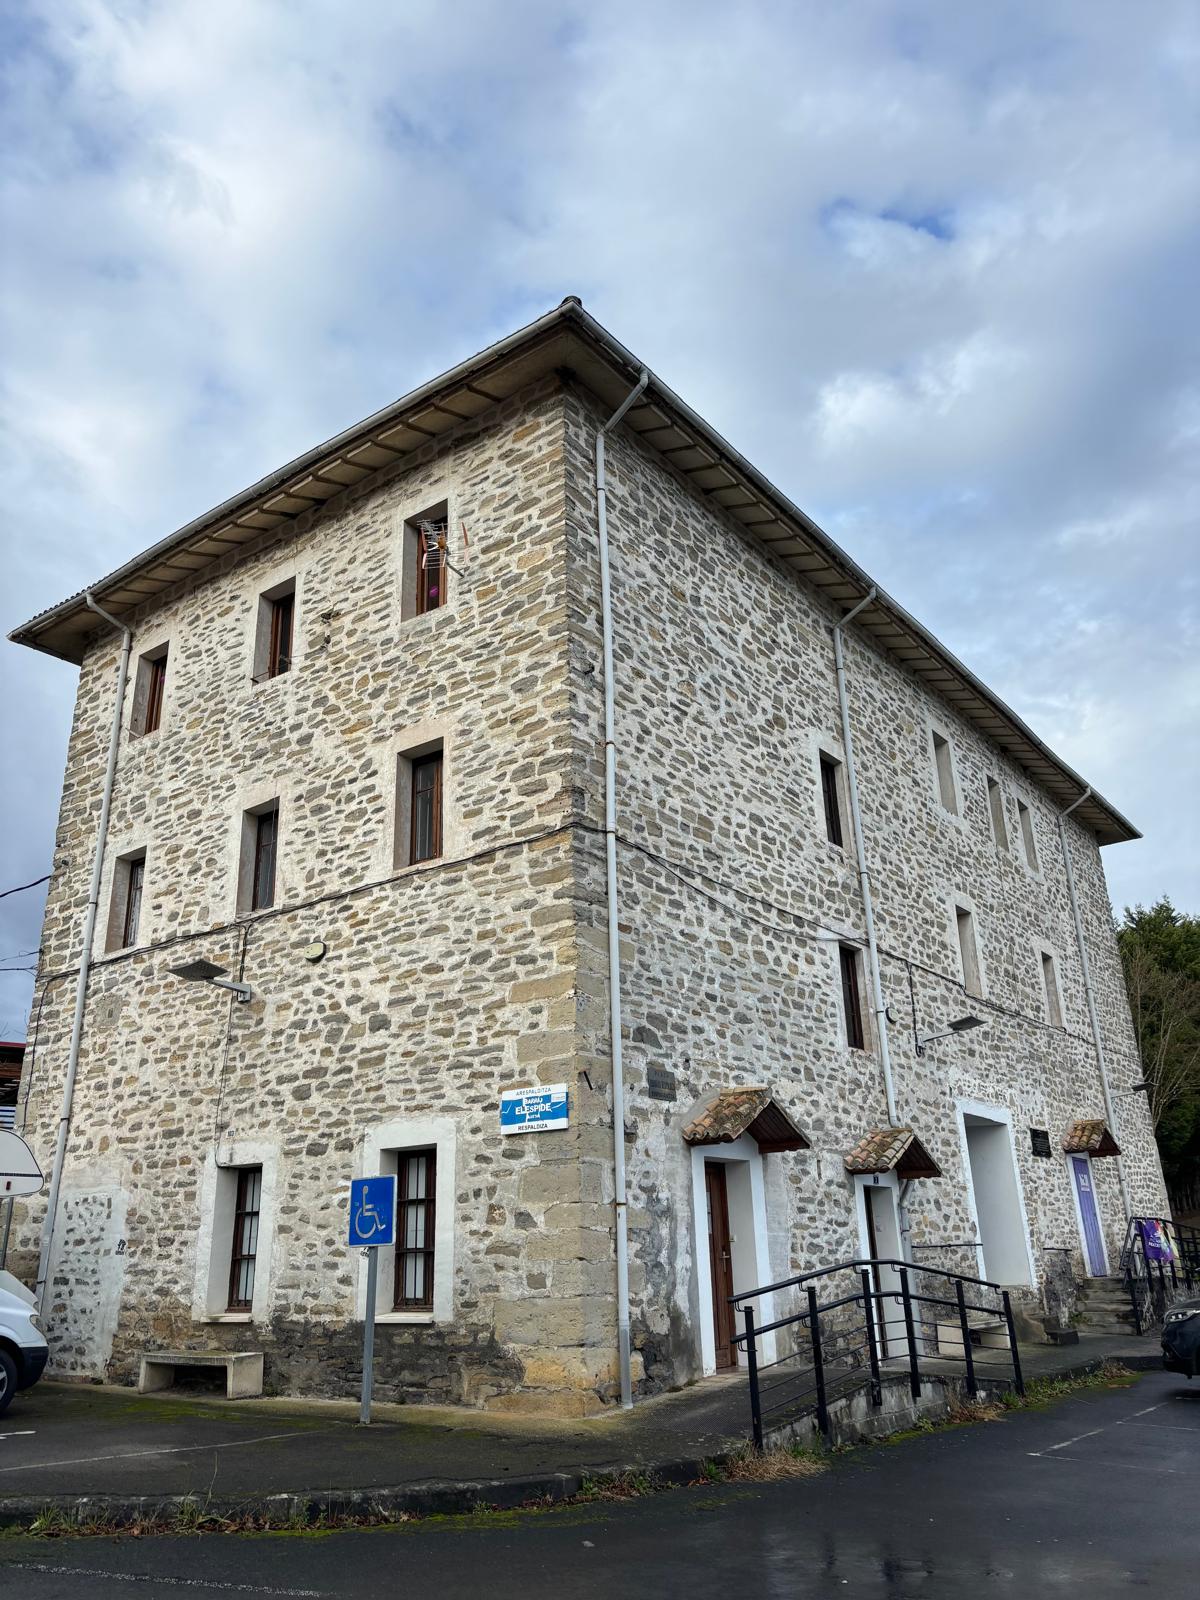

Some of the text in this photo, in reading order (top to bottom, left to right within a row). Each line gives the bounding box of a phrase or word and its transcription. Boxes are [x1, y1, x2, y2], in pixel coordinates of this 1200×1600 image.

[516, 1087, 551, 1096] ARESPALDITZA
[524, 1097, 543, 1105] BARRIO
[515, 1102, 552, 1115] ELESPIDE
[517, 1123, 548, 1131] RESPALDIZA
